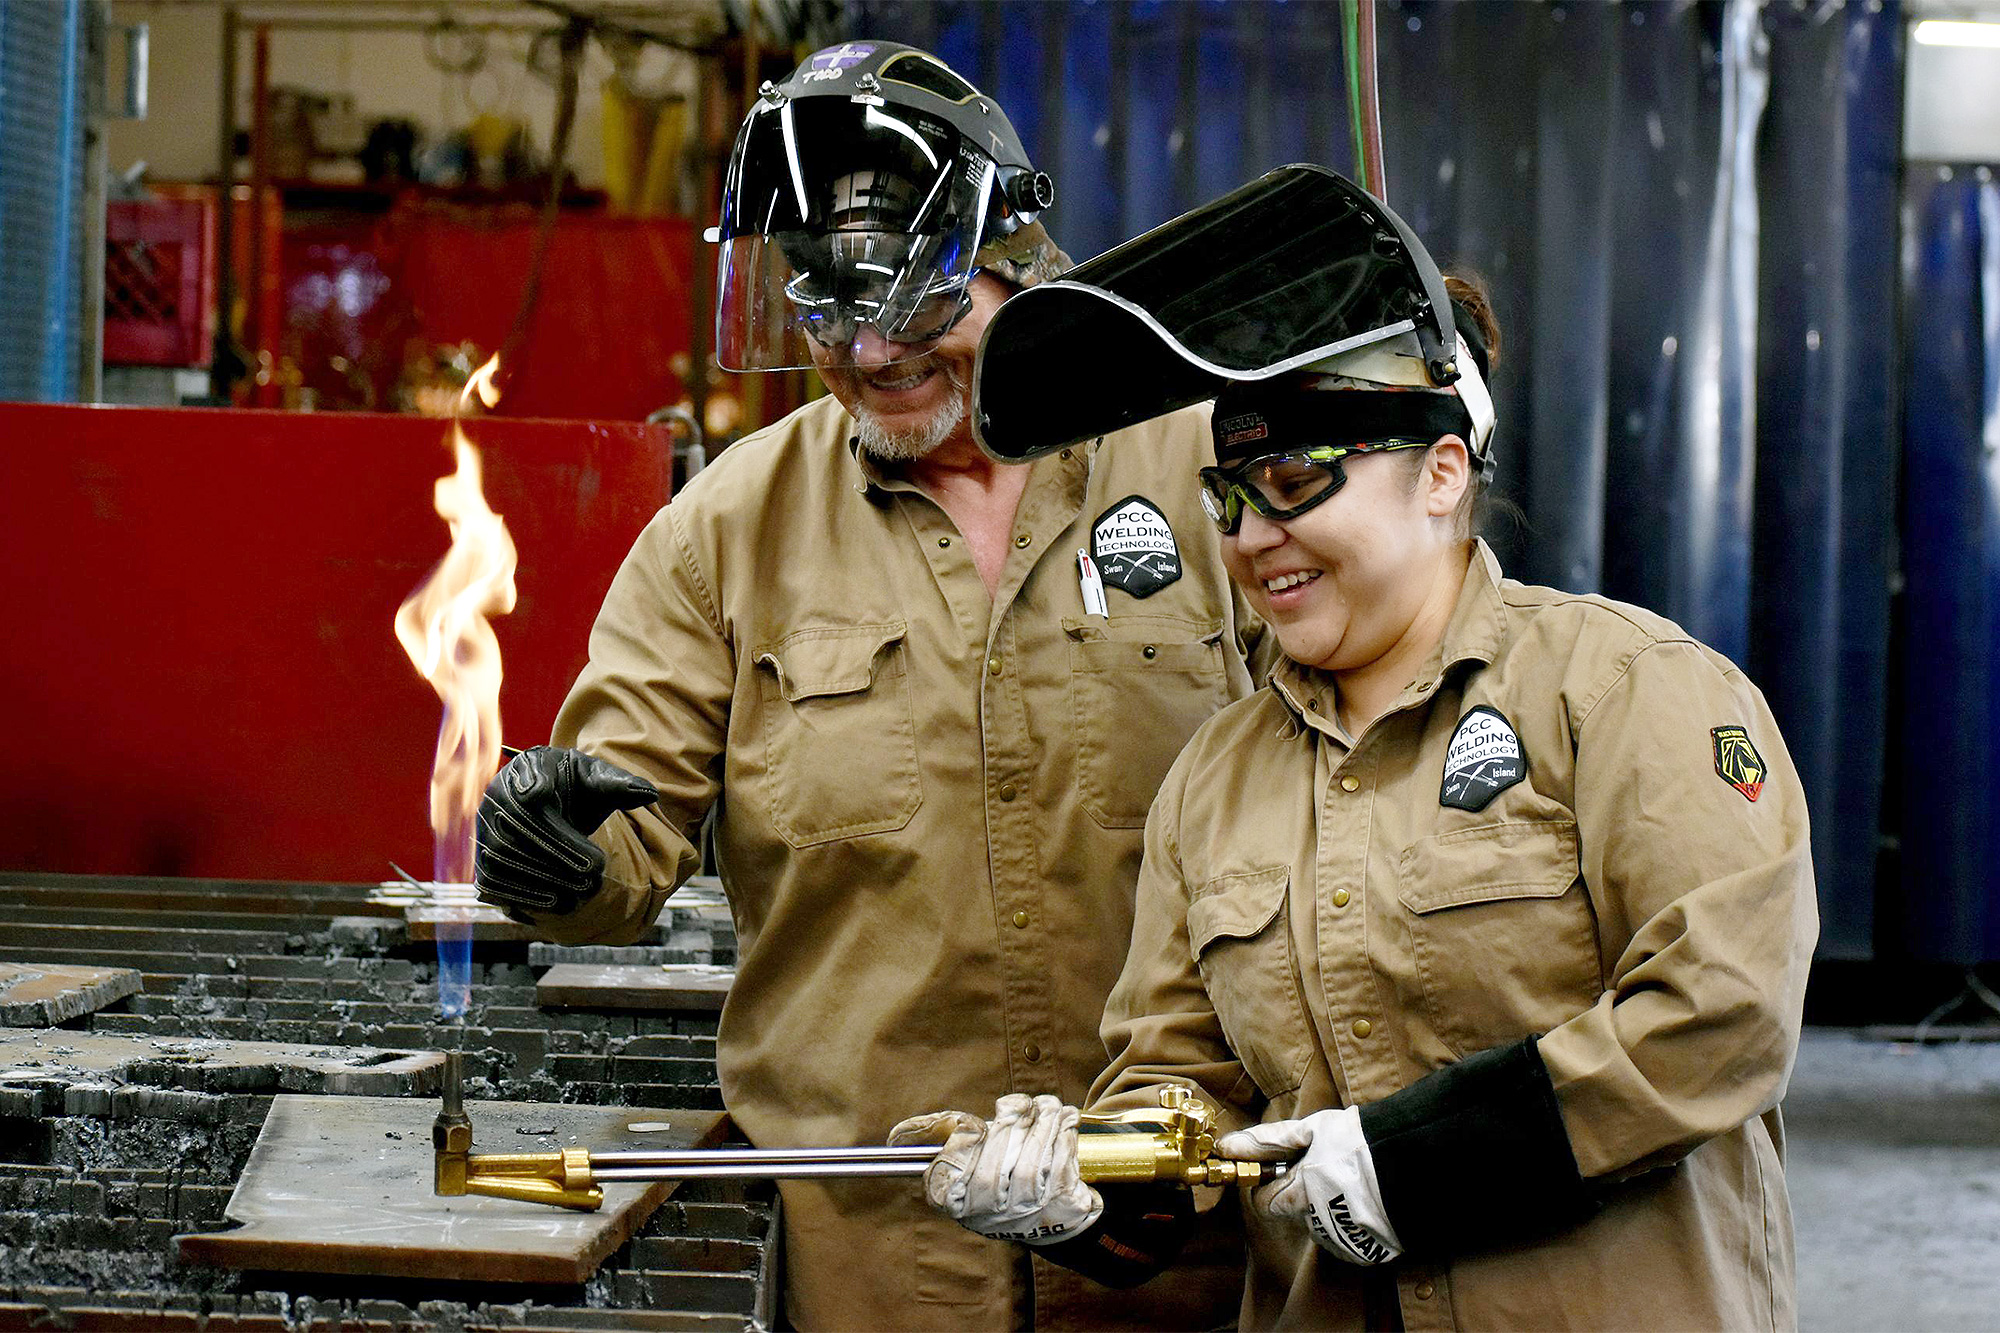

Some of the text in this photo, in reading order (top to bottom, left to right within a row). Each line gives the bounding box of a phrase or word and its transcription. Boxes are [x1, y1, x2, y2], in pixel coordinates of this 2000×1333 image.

[1117, 512, 1153, 524] PCC
[1096, 526, 1174, 541] WELDING
[1097, 540, 1174, 553] TECHNOLOGY
[1104, 561, 1177, 575] Swan Island
[1460, 718, 1492, 740] PCC
[1493, 767, 1516, 778] Island
[1327, 1193, 1391, 1265] VULCAN
